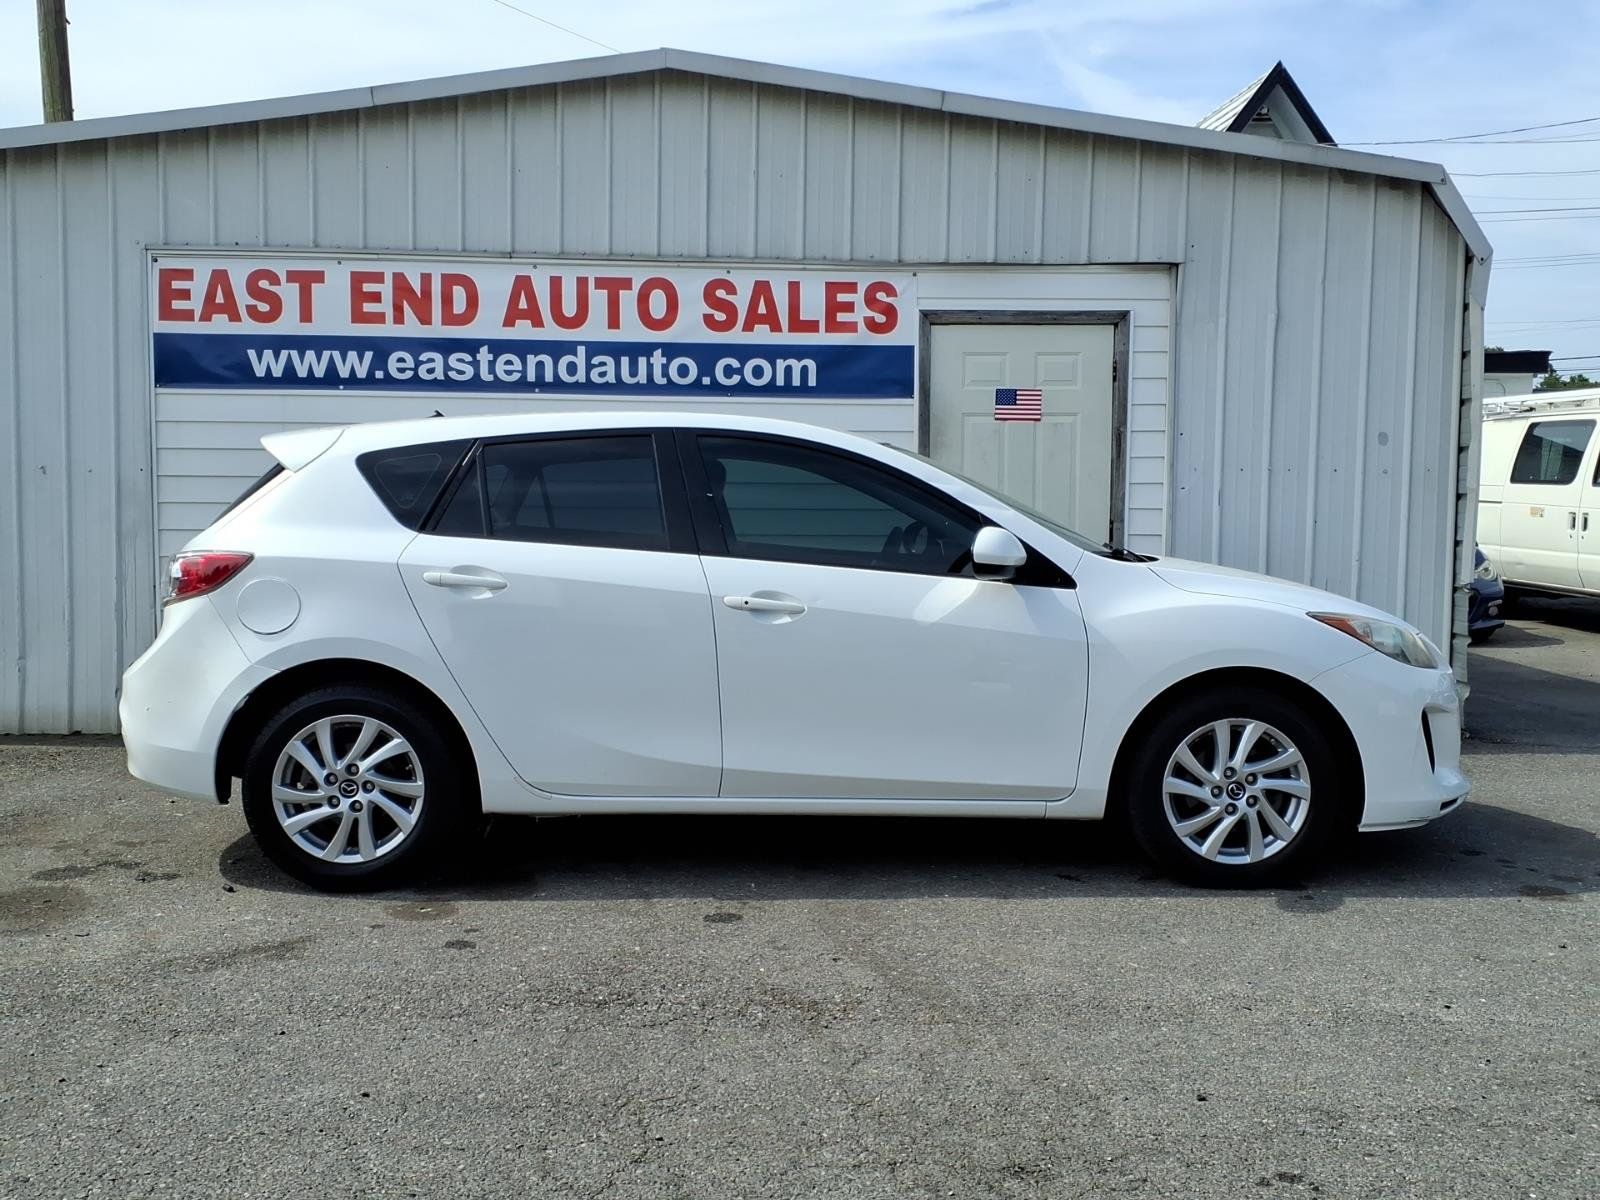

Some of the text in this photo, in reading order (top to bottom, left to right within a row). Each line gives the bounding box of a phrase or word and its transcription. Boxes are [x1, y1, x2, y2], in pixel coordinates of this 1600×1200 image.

[158, 269, 899, 336] EAST END AUTO SALES
[247, 345, 818, 387] www.eastendauto.com
